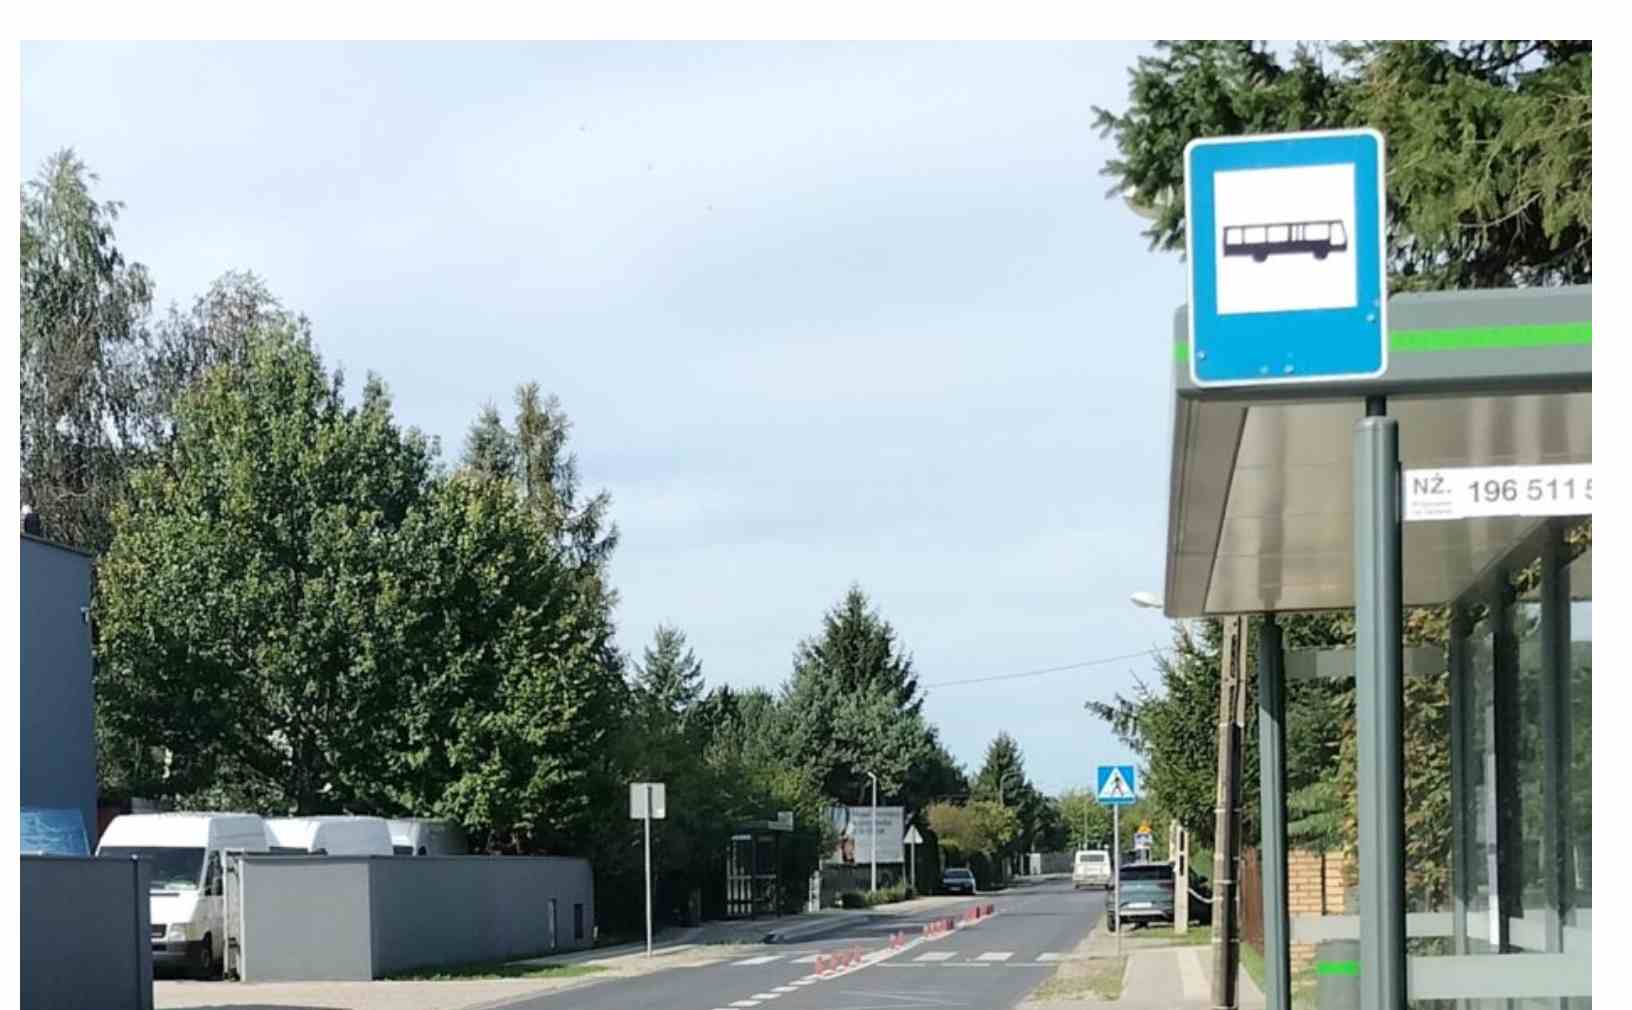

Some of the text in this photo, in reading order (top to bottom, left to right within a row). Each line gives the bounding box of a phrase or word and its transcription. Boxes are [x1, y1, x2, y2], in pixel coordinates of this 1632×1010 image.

[1413, 472, 1452, 495] NŻ.
[1468, 480, 1517, 502] 196
[1528, 478, 1574, 501] 511
